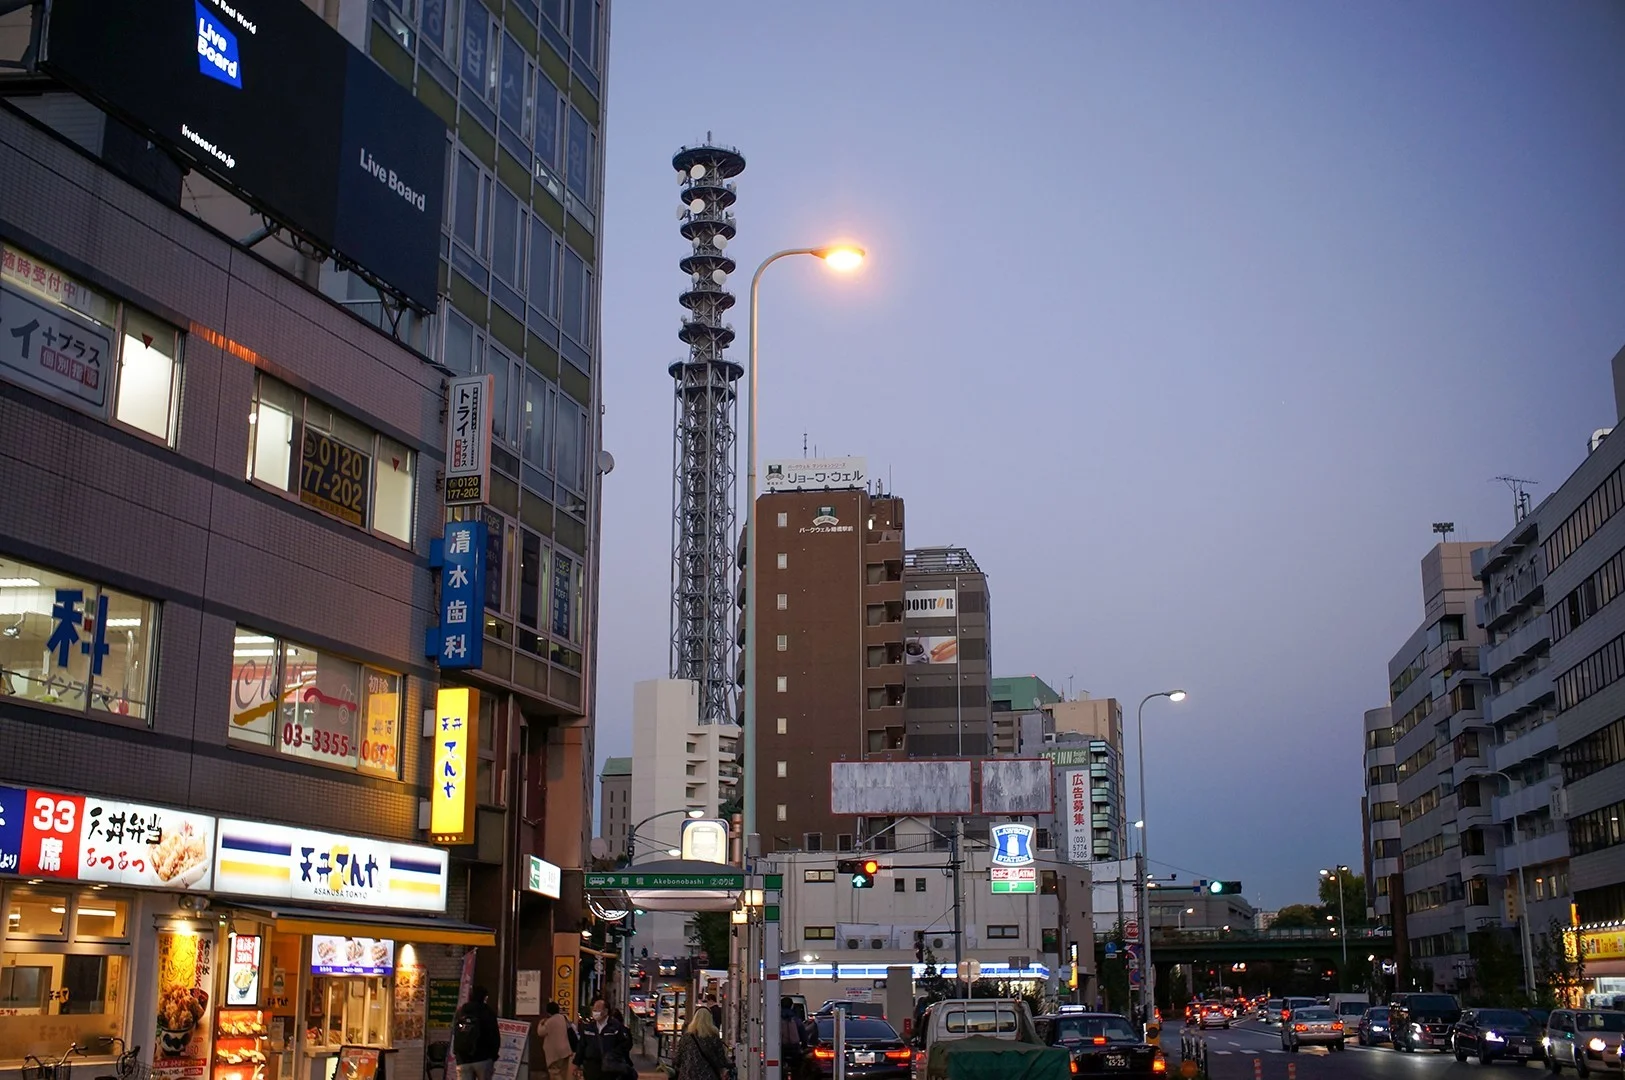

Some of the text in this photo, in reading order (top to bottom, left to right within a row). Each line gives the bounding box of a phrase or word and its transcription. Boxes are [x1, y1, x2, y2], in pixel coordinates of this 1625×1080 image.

[199, 17, 227, 52] Live
[220, 0, 256, 34] Real World
[197, 35, 238, 79] Board
[181, 124, 235, 169] liveboard.co.jp
[359, 147, 426, 212] Live Board
[457, 388, 470, 436] トライ
[320, 437, 362, 480] 0120
[447, 488, 479, 499] 177-202
[457, 477, 479, 488] 0120
[444, 530, 471, 660] 清水歯科
[47, 589, 109, 675] 科
[443, 741, 457, 798] てんや
[1057, 751, 1072, 765] INN
[33, 797, 76, 834] 33
[1072, 773, 1085, 825] 広告募集
[87, 806, 163, 845] 天丼弁当
[996, 828, 1029, 836] LAWSON
[0, 853, 17, 870] より
[38, 837, 64, 872] 席
[86, 848, 145, 873] あつあつ
[997, 855, 1029, 863] STATION
[653, 877, 704, 886] Akebonobashi
[1009, 882, 1018, 893] P
[1019, 869, 1034, 879] ATM
[313, 887, 368, 899] ASAKUSA TOKYO
